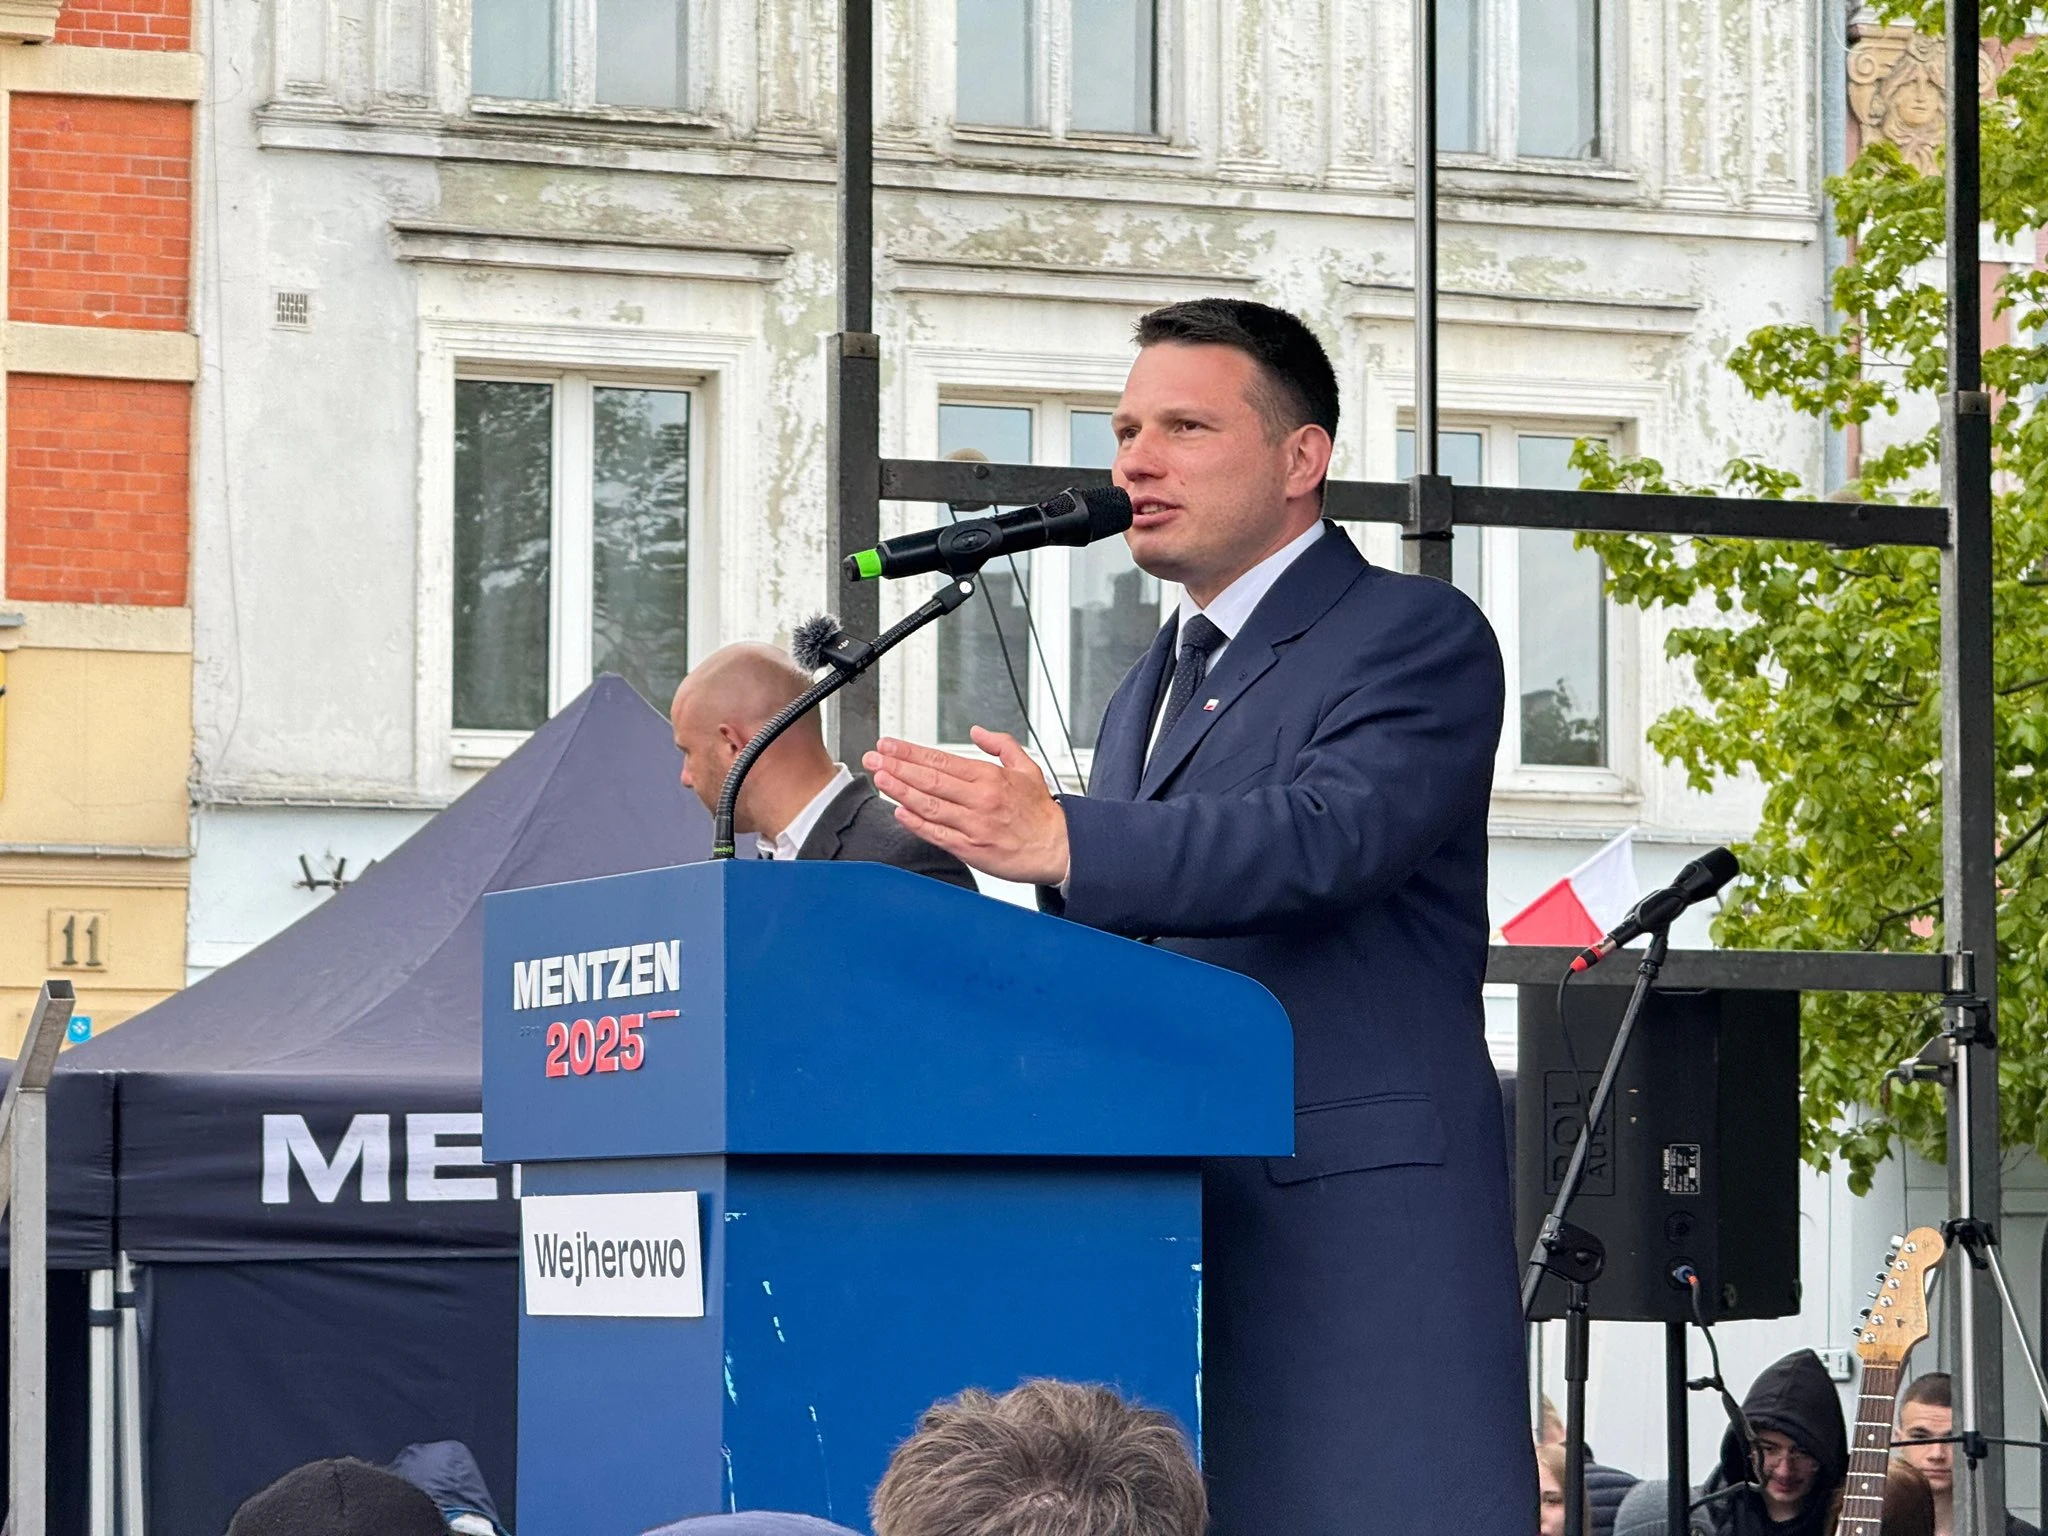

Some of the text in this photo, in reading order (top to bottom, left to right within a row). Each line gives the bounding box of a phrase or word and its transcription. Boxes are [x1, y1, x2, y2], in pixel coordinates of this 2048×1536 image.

[61, 915, 103, 967] 11
[513, 940, 681, 1010] MENTZEN
[545, 1014, 646, 1078] 2025
[261, 1113, 522, 1204] ME
[534, 1231, 686, 1287] Wejherowo
